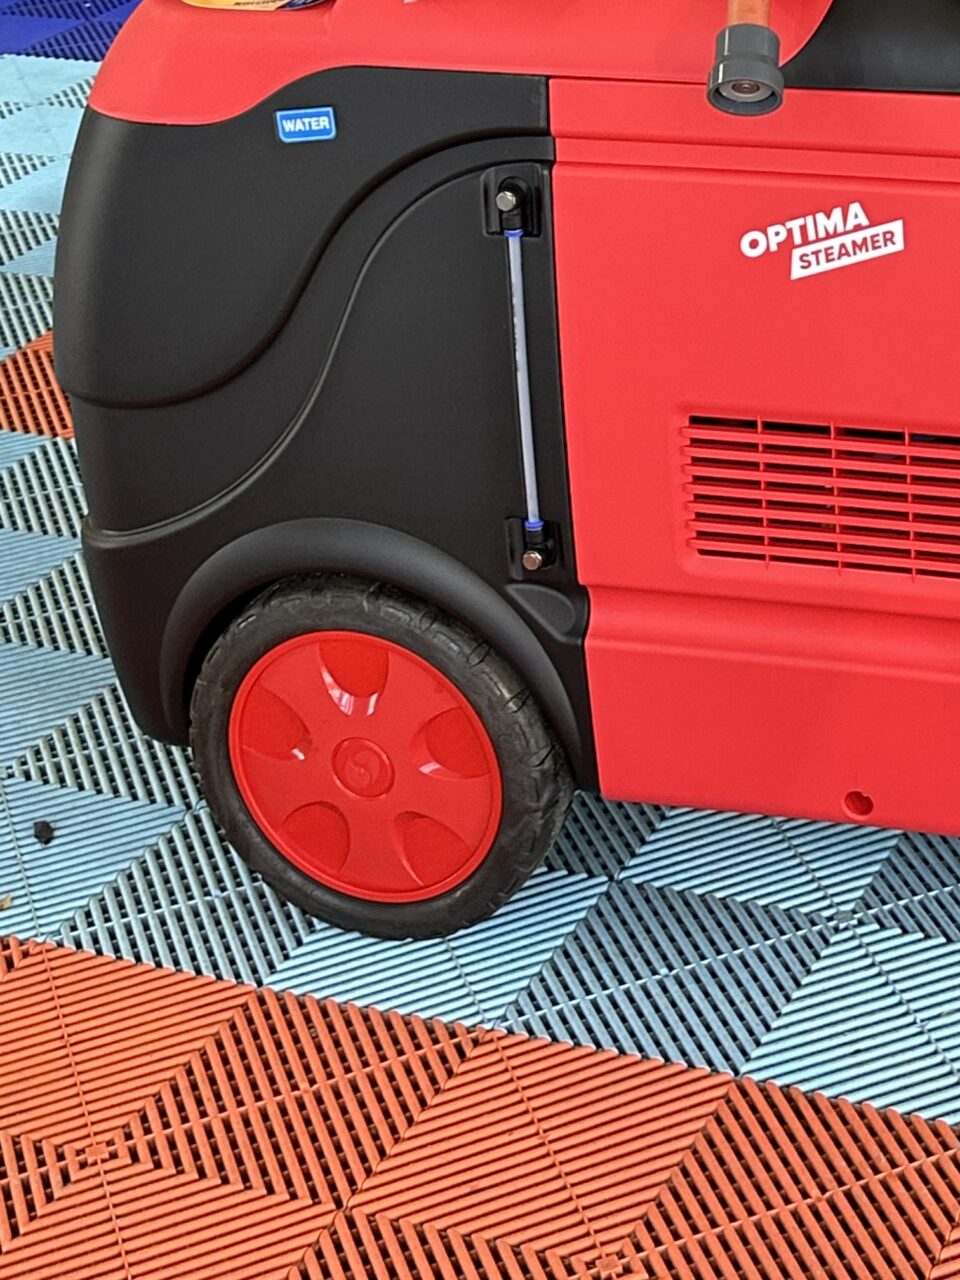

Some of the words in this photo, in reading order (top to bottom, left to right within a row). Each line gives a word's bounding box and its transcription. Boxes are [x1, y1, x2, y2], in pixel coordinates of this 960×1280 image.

[282, 116, 330, 133] WATER
[739, 201, 870, 258] OPTIMA
[798, 230, 897, 270] STEAMER
